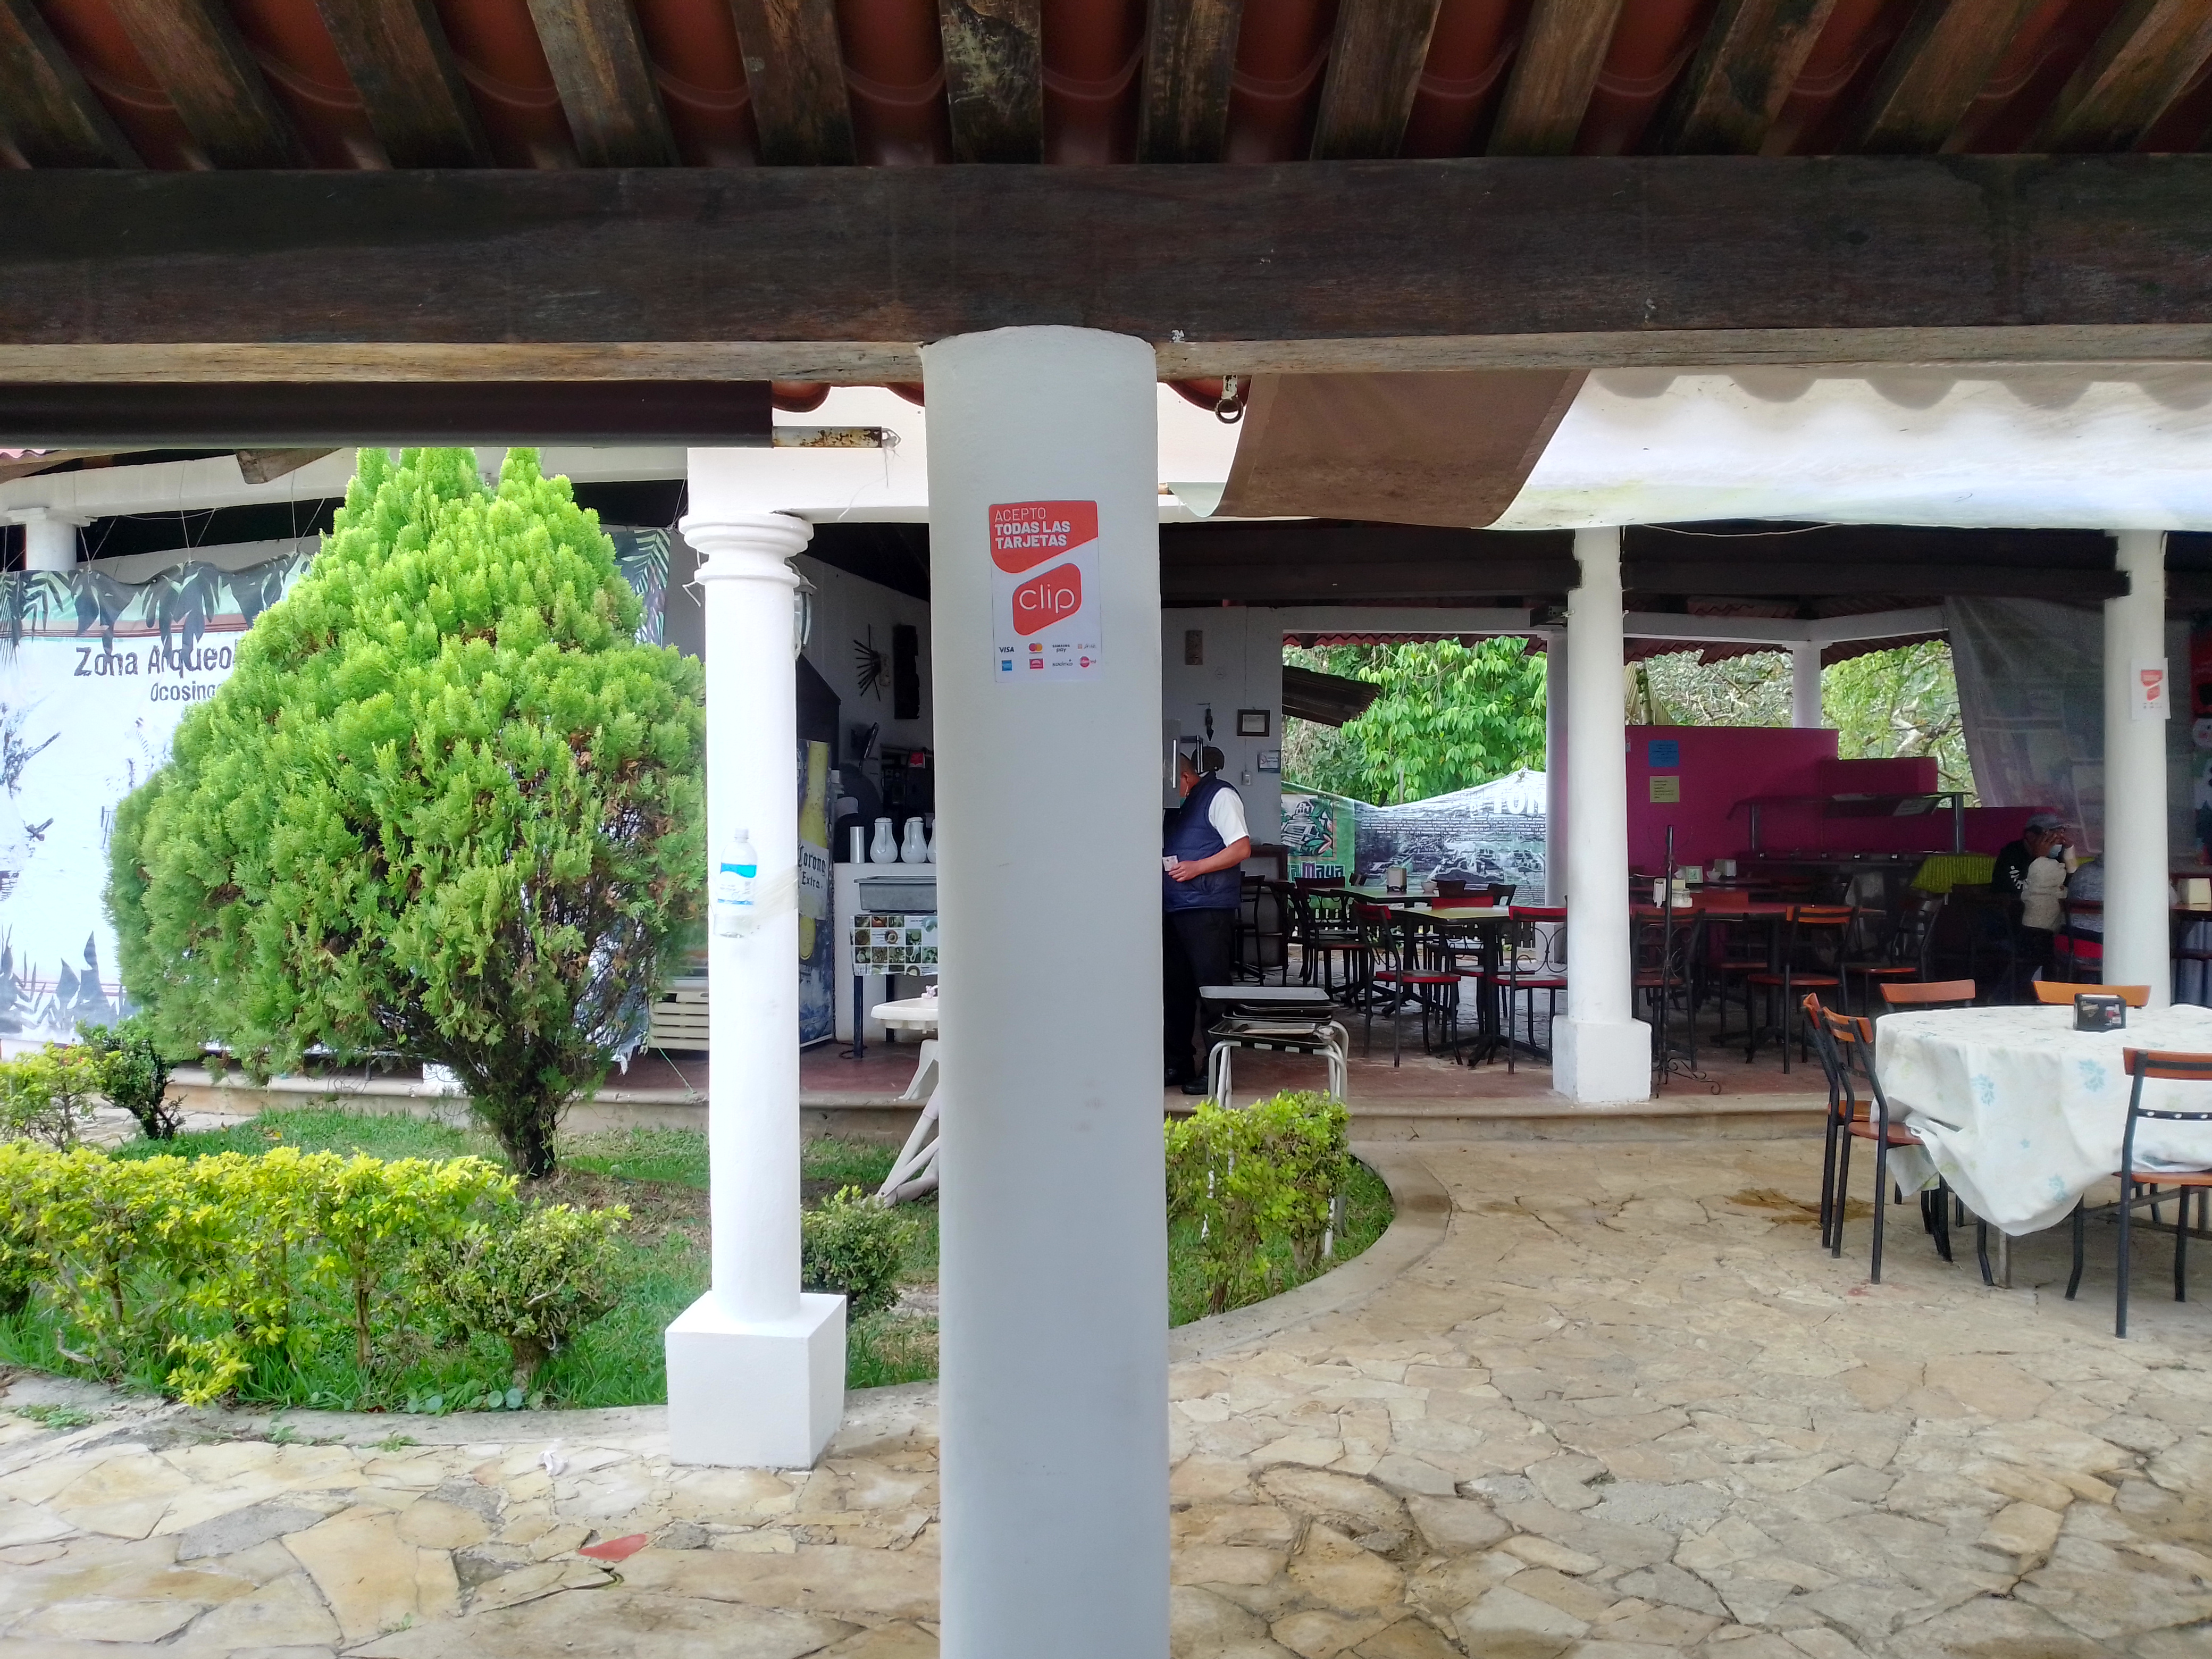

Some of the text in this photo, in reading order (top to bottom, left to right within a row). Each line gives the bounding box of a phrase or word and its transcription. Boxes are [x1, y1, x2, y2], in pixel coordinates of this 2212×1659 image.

[994, 507, 1046, 523] ACEPTO
[994, 520, 1071, 536] TODAS LAS
[995, 534, 1068, 550] TARJETAS
[1019, 584, 1075, 614] clip
[73, 647, 138, 676] Zona
